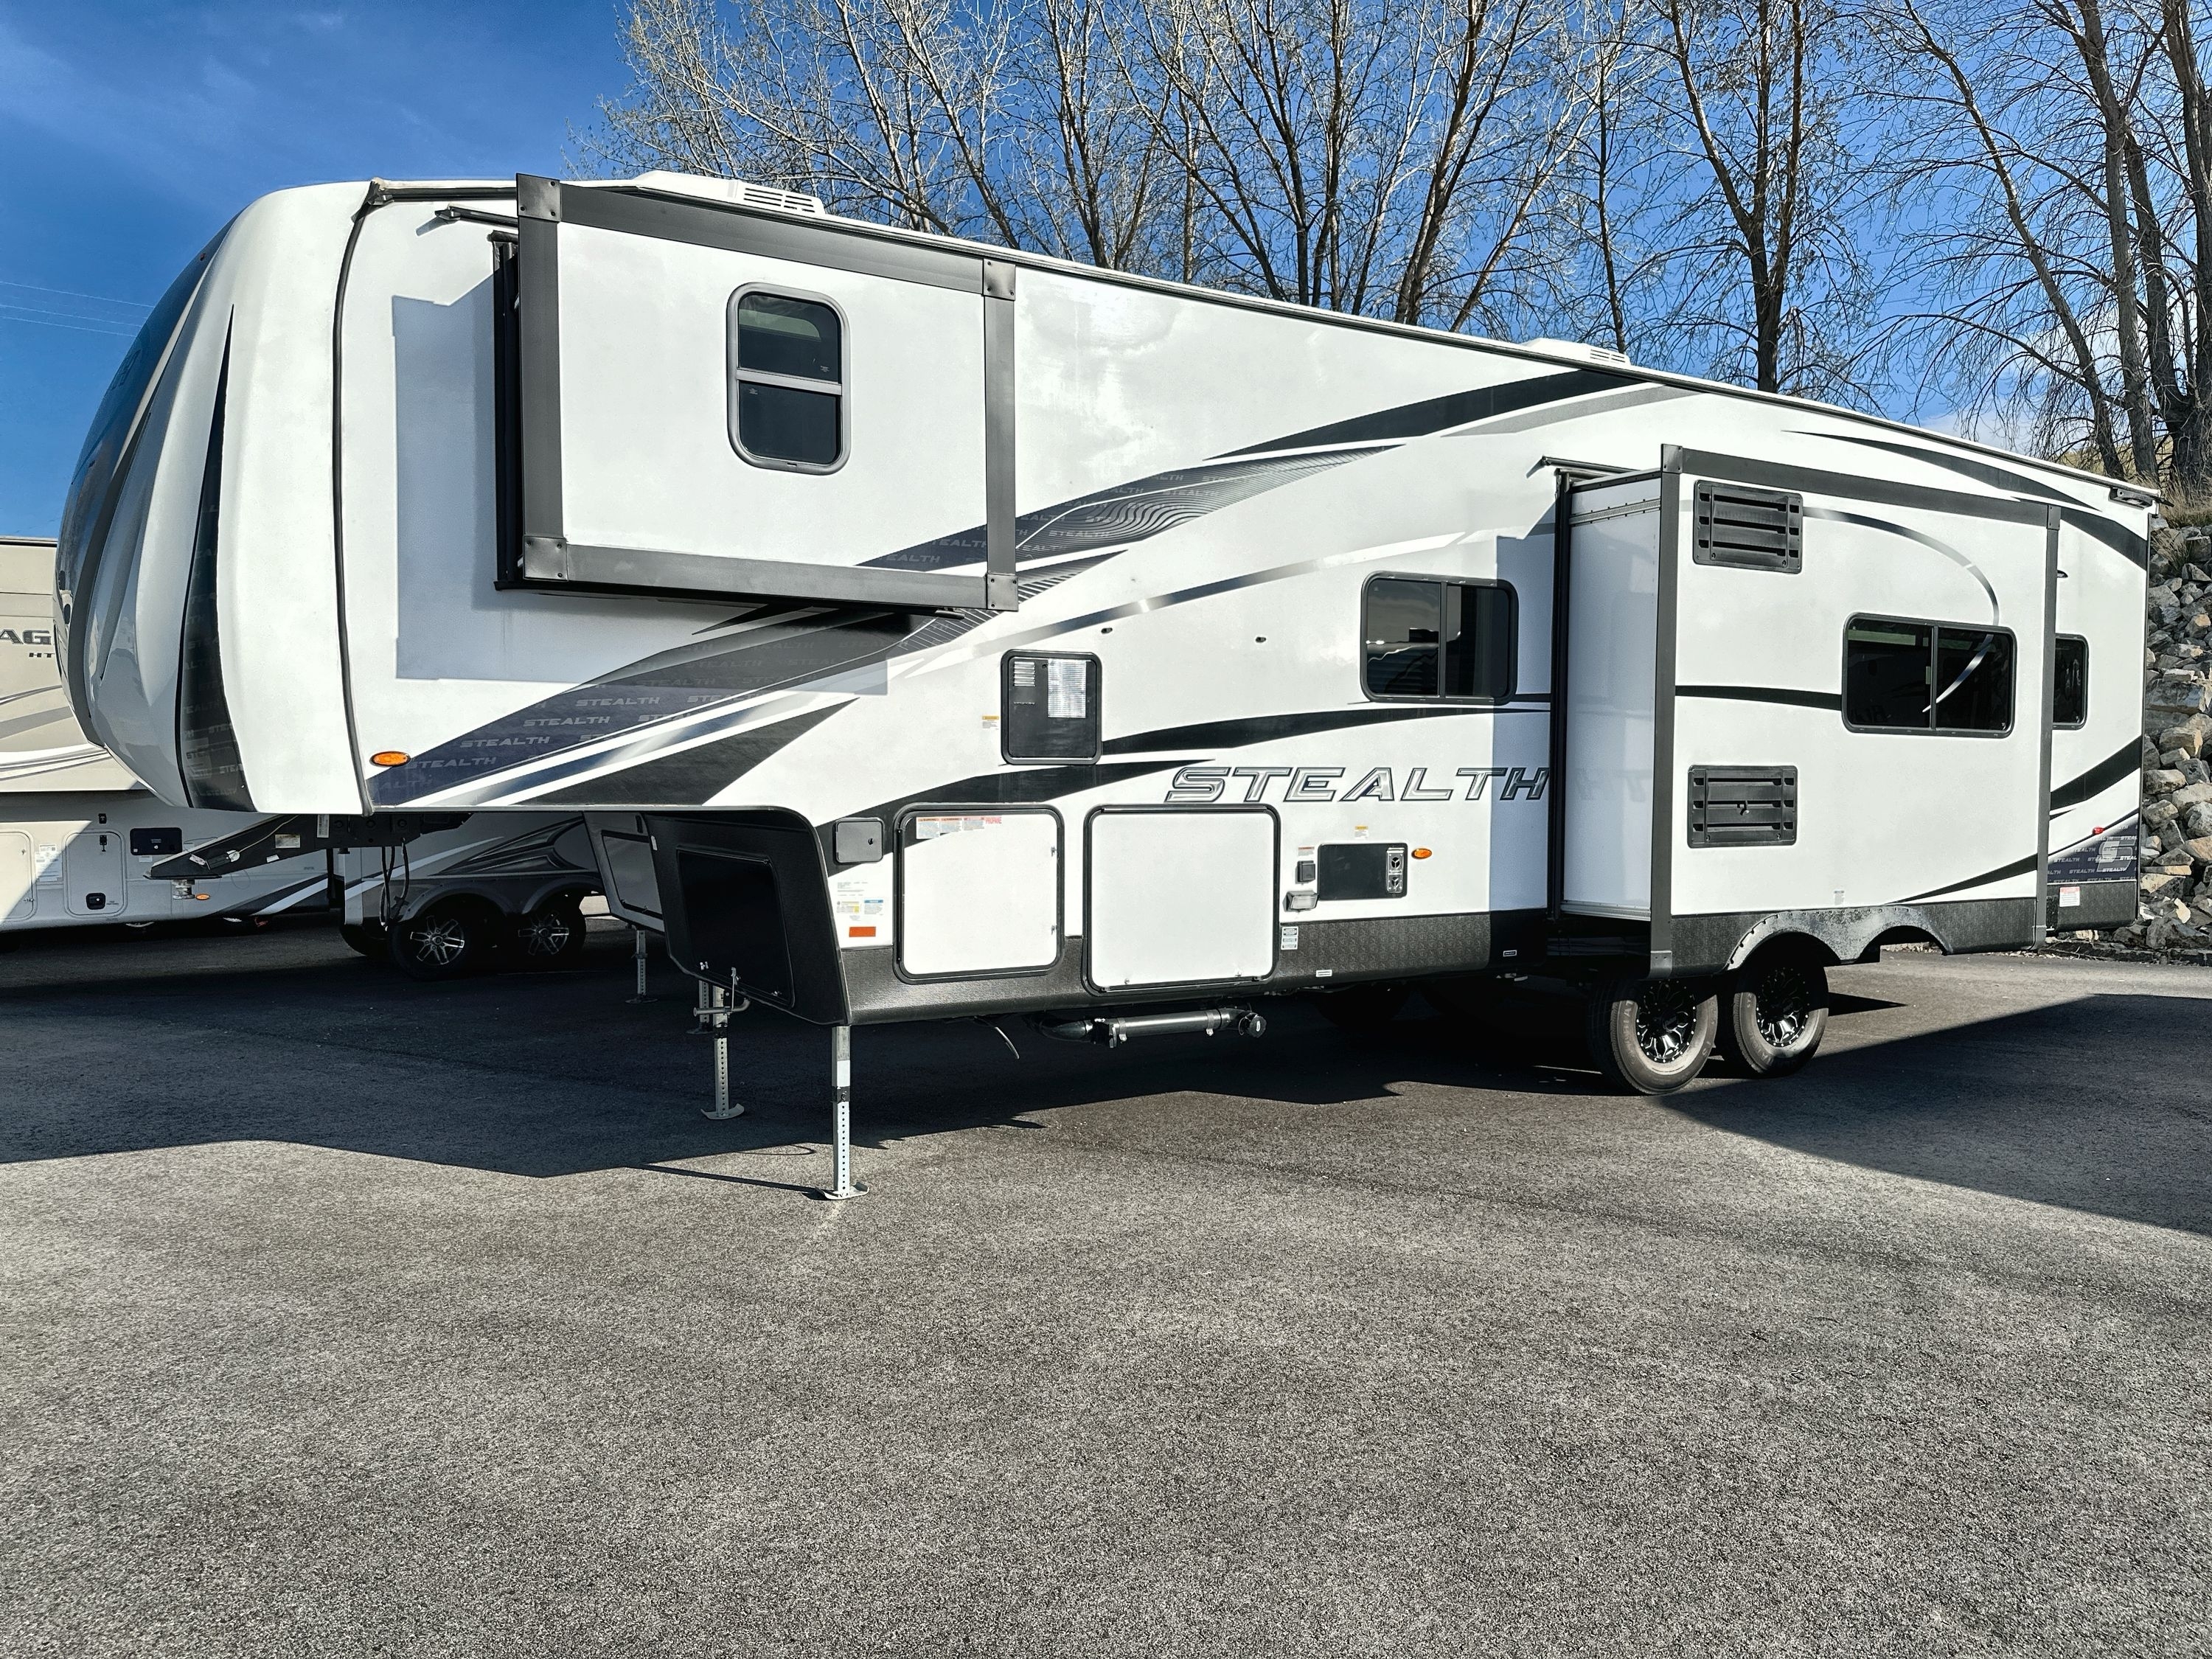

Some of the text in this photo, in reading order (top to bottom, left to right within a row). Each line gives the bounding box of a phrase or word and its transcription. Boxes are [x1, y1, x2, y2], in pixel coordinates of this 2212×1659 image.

[886, 554, 941, 563] EALTH
[575, 697, 660, 707] STEALTH
[523, 716, 611, 727] STEALTH
[459, 737, 550, 748] STEALTH
[405, 757, 496, 769] STEALTH
[1165, 767, 1550, 802] STEALTH
